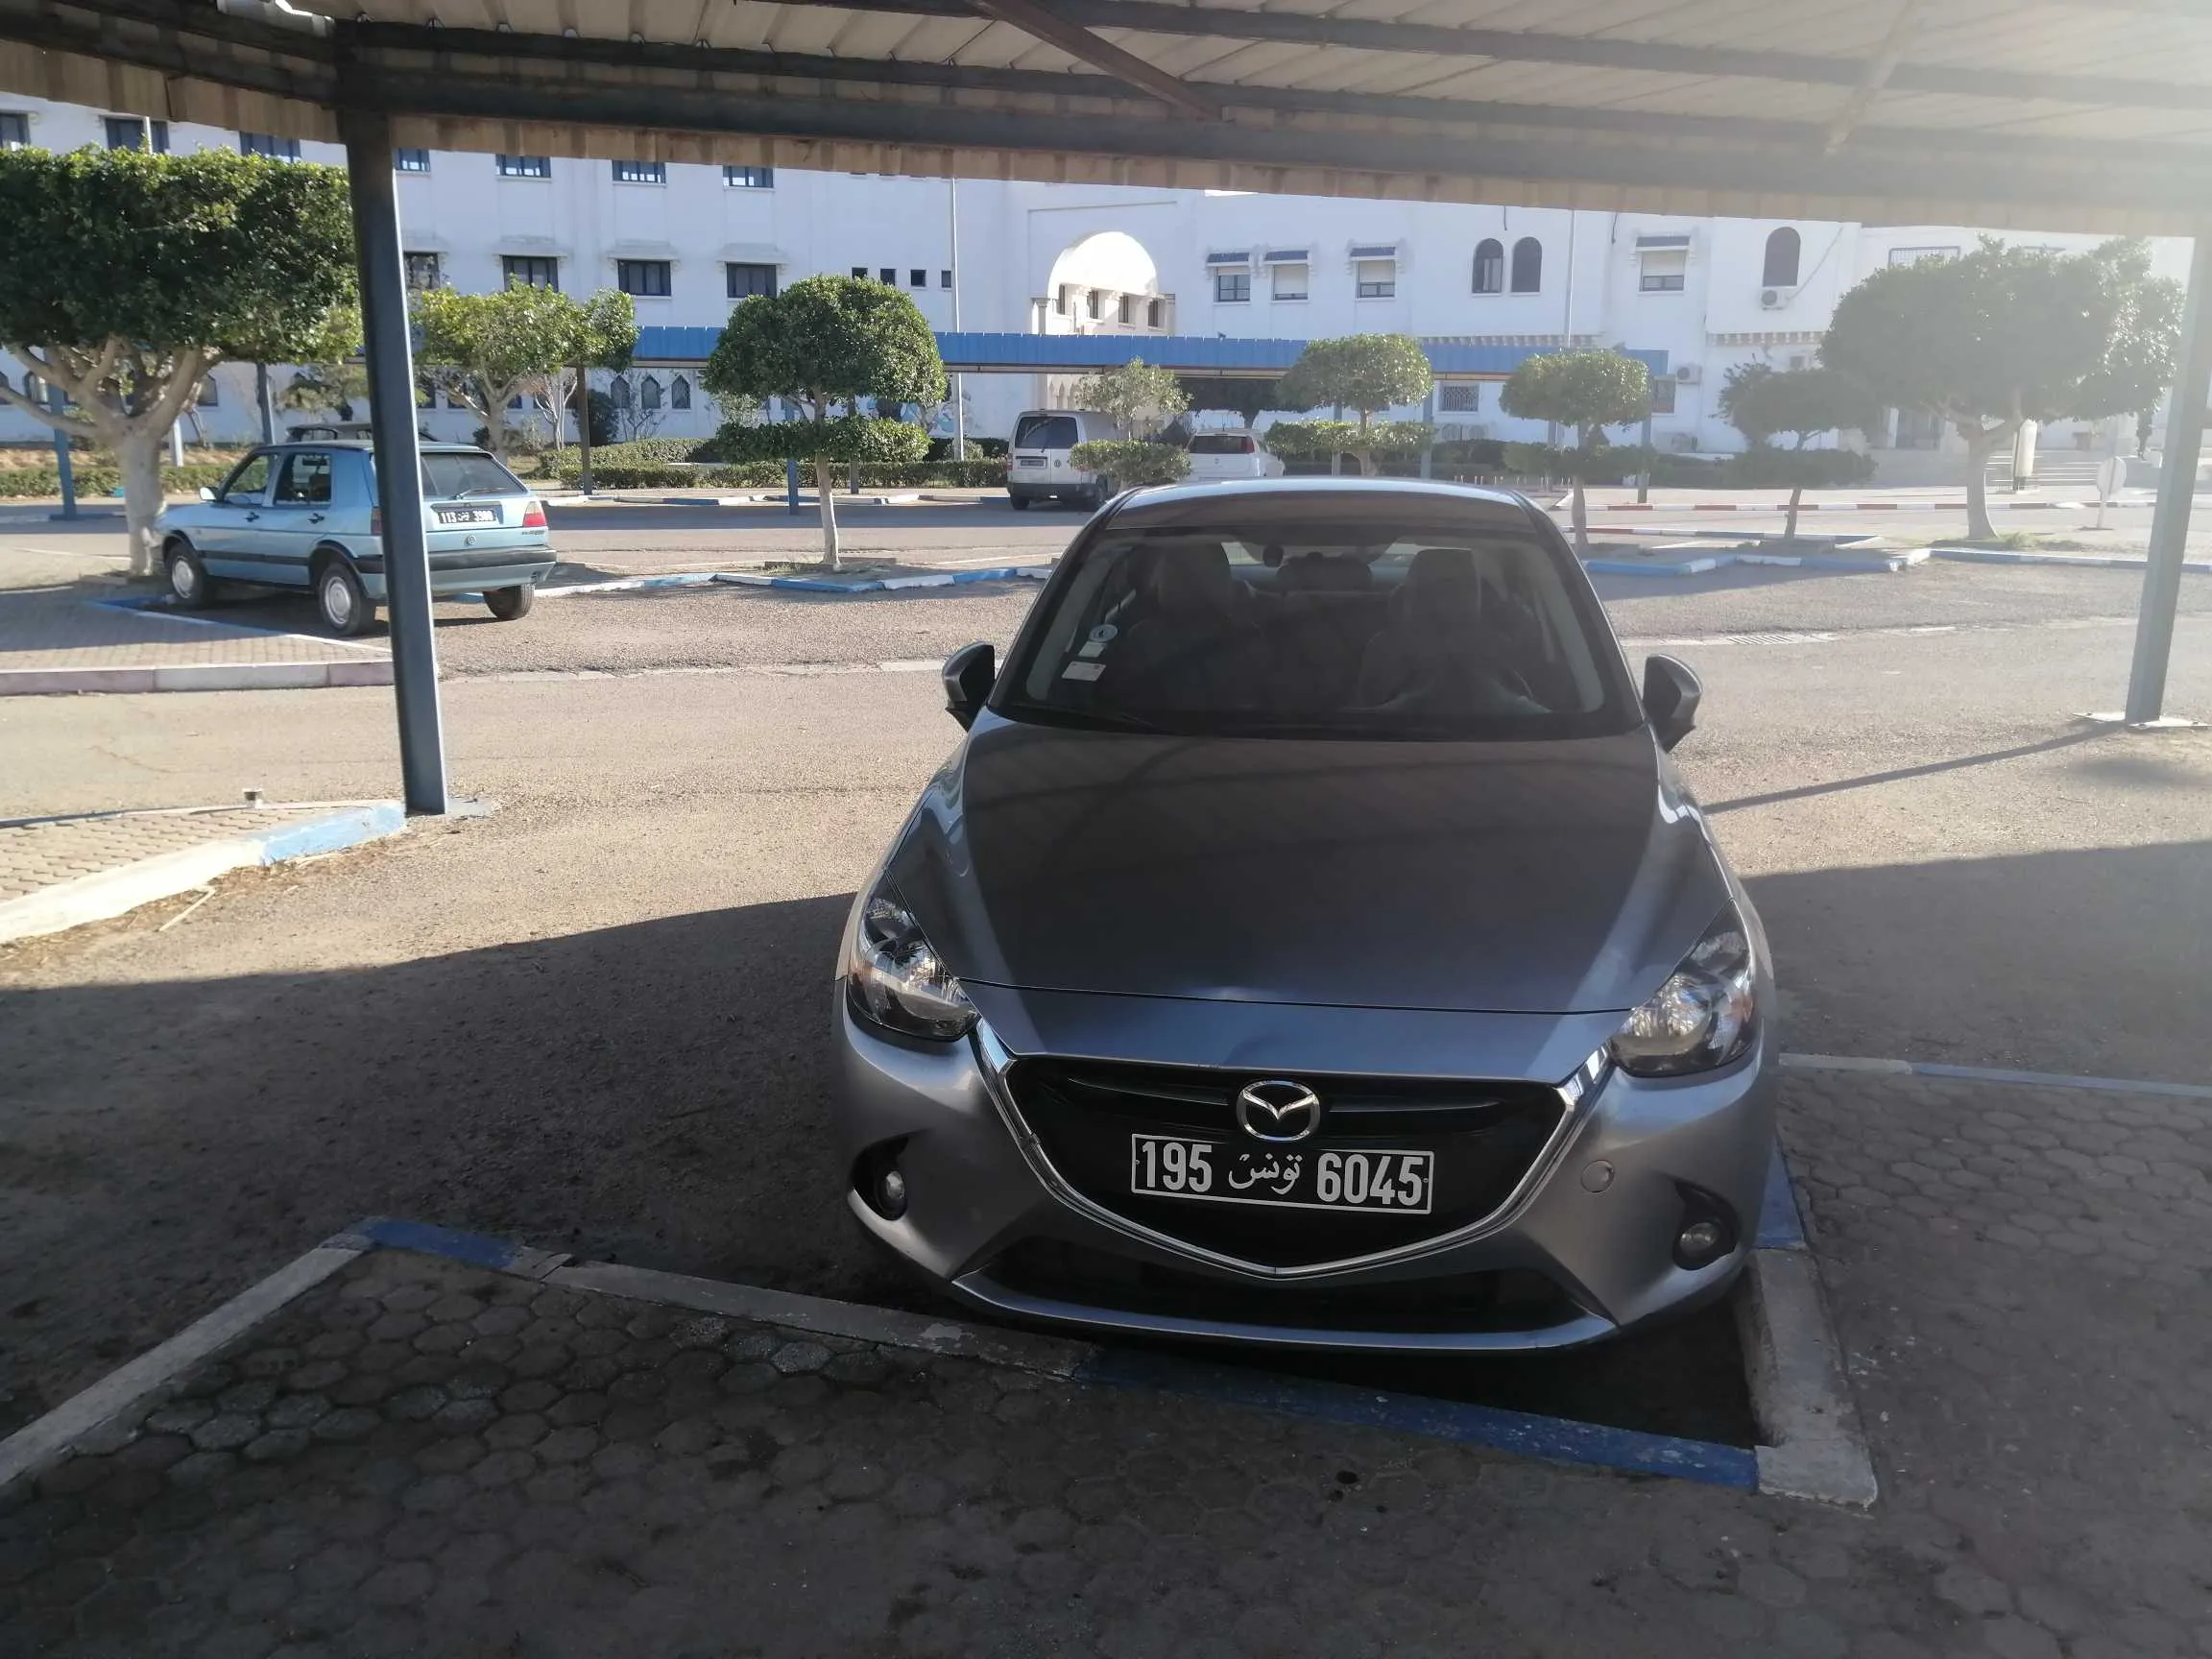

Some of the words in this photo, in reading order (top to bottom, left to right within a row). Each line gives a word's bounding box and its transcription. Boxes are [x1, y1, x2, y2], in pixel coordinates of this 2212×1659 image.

[1142, 1141, 1213, 1192] 195
[1228, 1152, 1303, 1195] تونس
[1316, 1152, 1424, 1206] 6045
